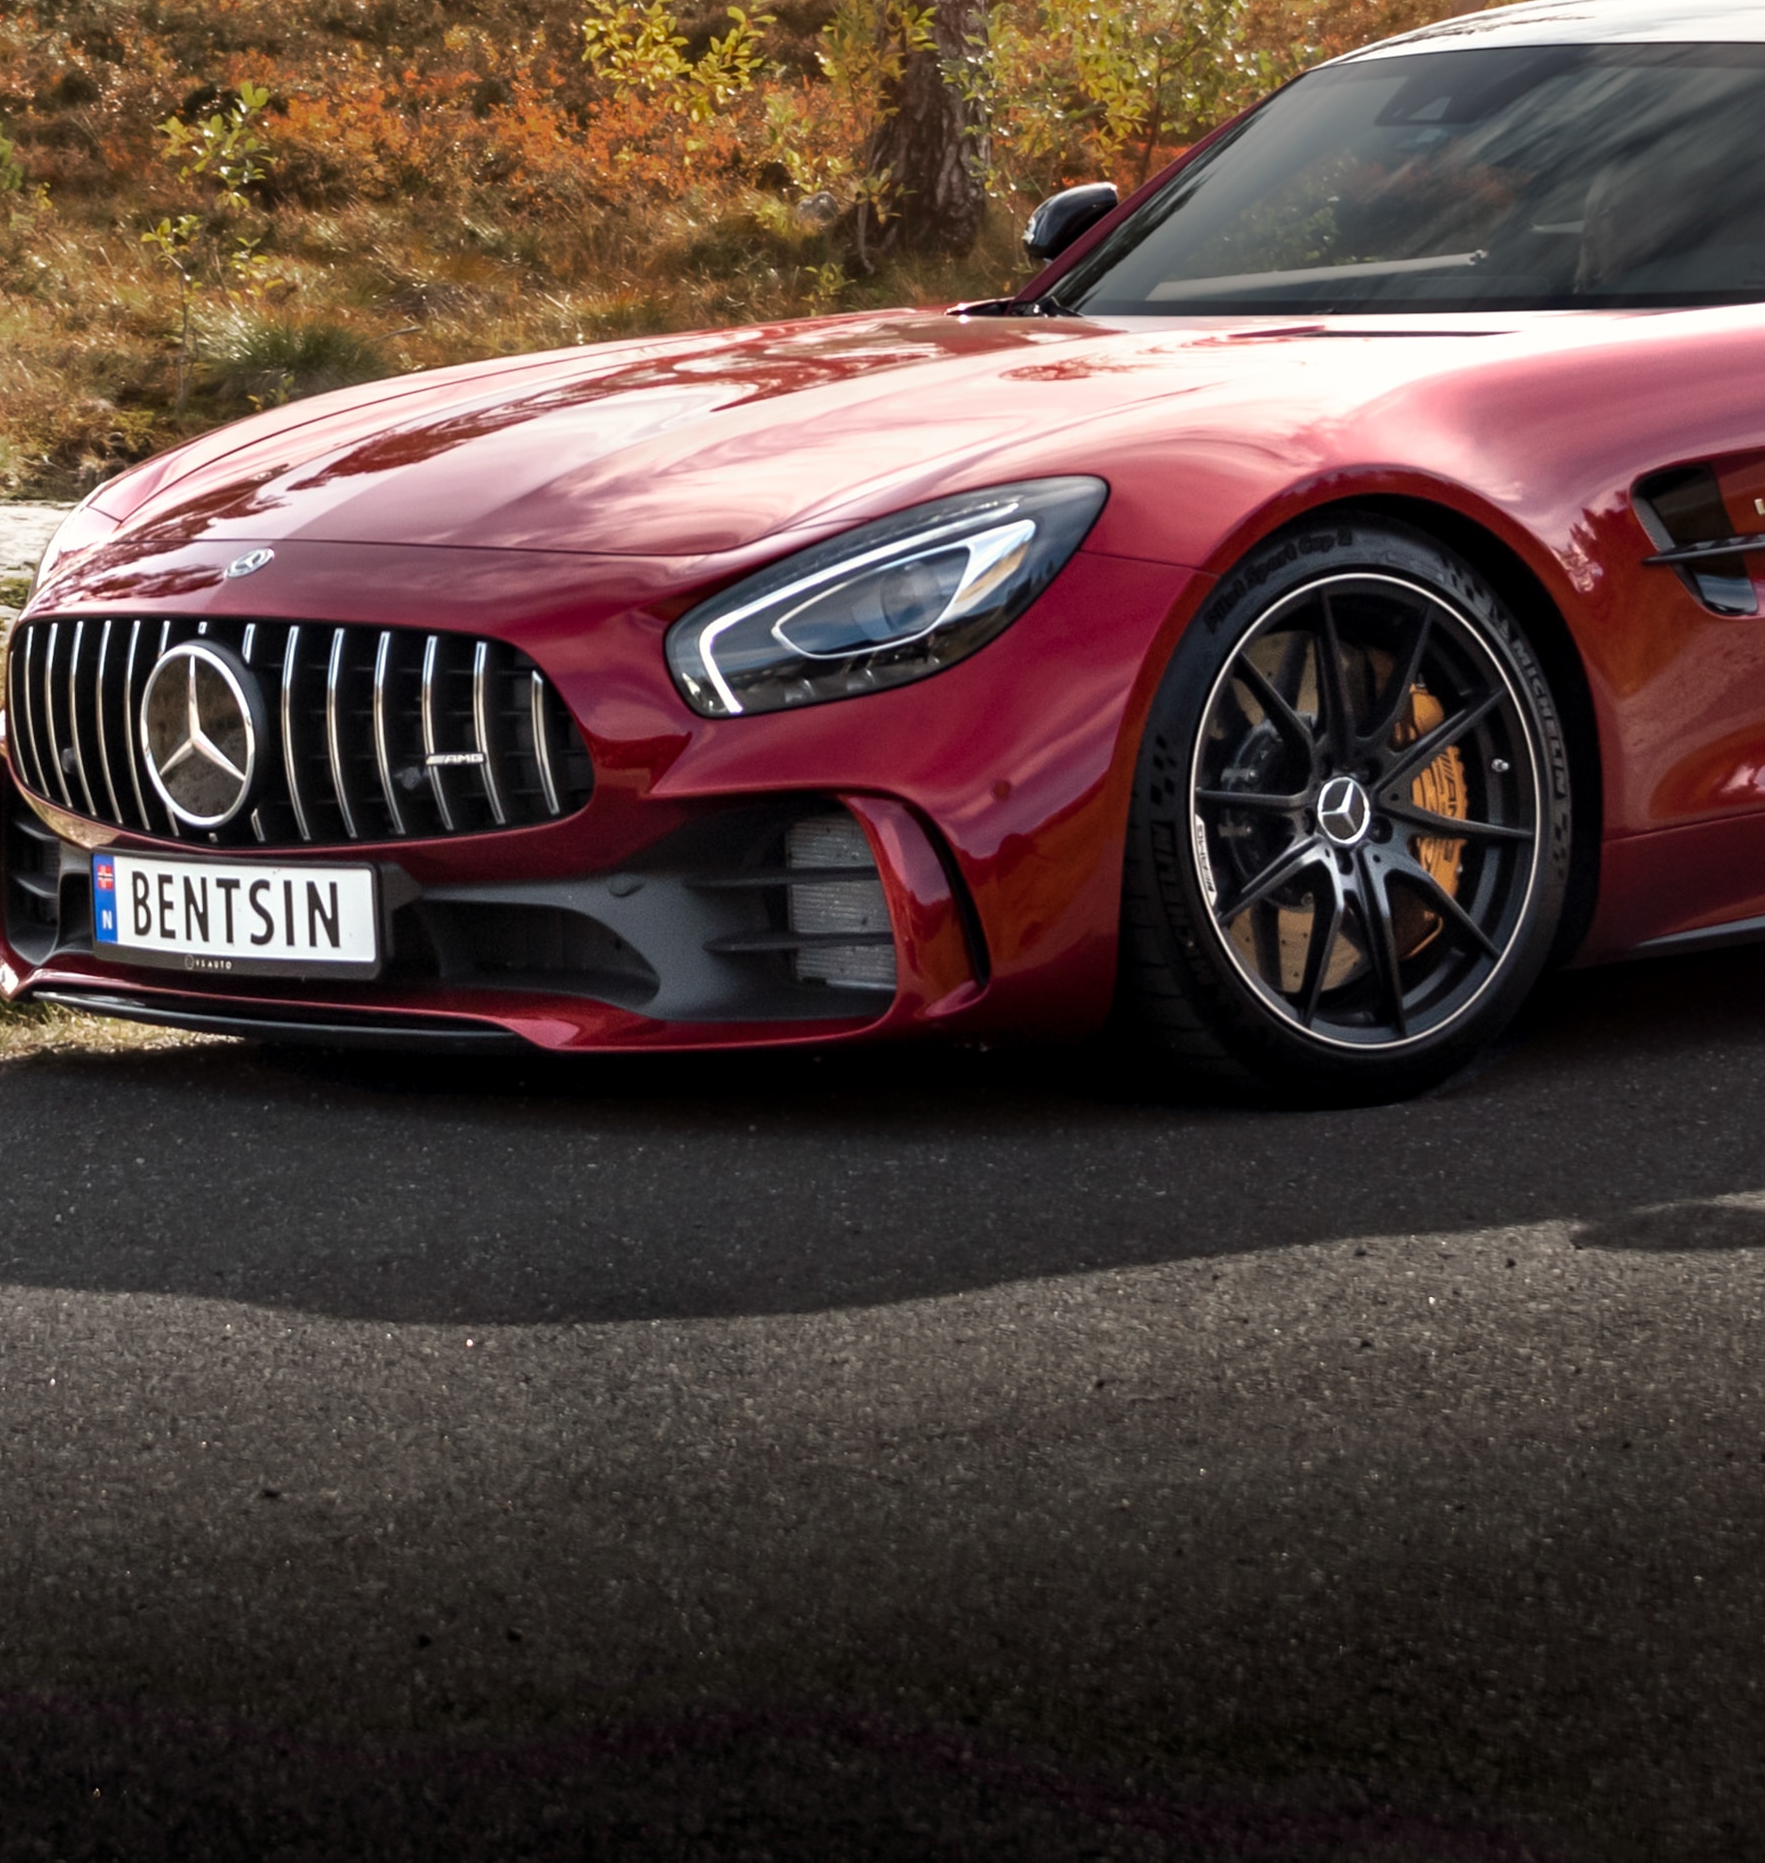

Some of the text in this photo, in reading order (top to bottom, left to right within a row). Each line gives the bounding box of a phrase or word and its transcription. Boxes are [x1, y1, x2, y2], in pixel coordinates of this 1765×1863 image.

[1243, 541, 1297, 585] Sport
[1299, 531, 1334, 555] Cup
[1511, 637, 1567, 799] MICHELIN
[442, 753, 484, 764] AMG
[101, 909, 113, 930] N
[131, 870, 340, 948] BENTSIN
[1152, 824, 1216, 986] MICHELIN
